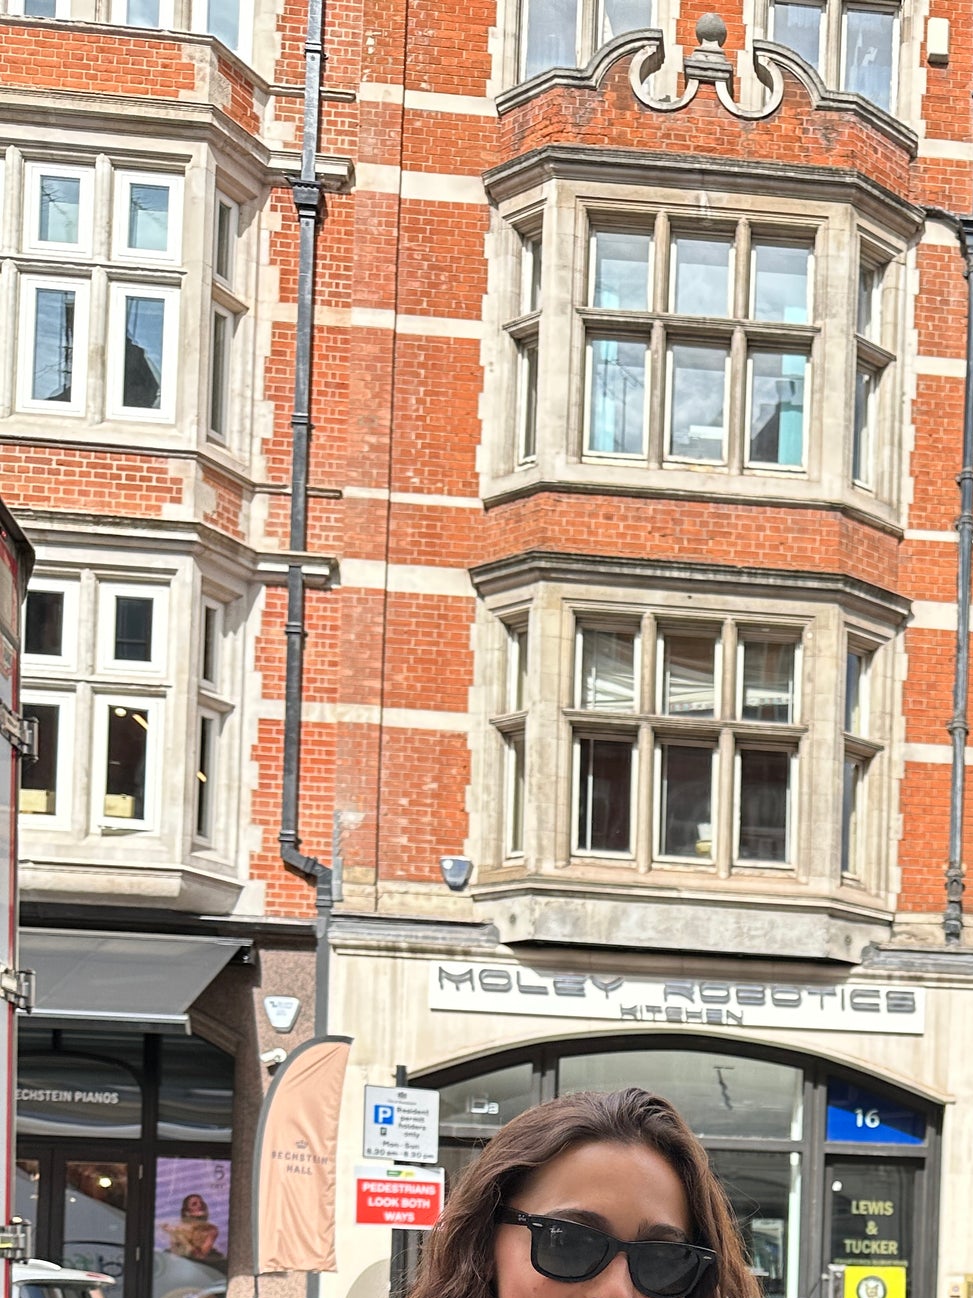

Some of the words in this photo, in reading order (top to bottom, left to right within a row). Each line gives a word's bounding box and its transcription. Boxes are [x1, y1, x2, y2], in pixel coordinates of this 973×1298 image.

[438, 966, 624, 1000] MOLEY
[664, 980, 916, 1014] ROBOTICS
[15, 1088, 72, 1102] ECHSTEIN
[74, 1090, 119, 1104] PIANOS
[377, 1106, 392, 1124] P
[396, 1106, 429, 1116] Resident
[855, 1108, 880, 1128] 16
[271, 1150, 328, 1165] BECHSTEIN
[286, 1164, 313, 1176] HALL
[362, 1181, 436, 1196] PEDESTRIANS
[367, 1196, 400, 1208] LOOK
[400, 1197, 431, 1209] BOTH
[851, 1200, 894, 1216] LEWIS
[383, 1211, 415, 1223] WAYS
[865, 1220, 879, 1235] &
[844, 1239, 898, 1255] TUCKER
